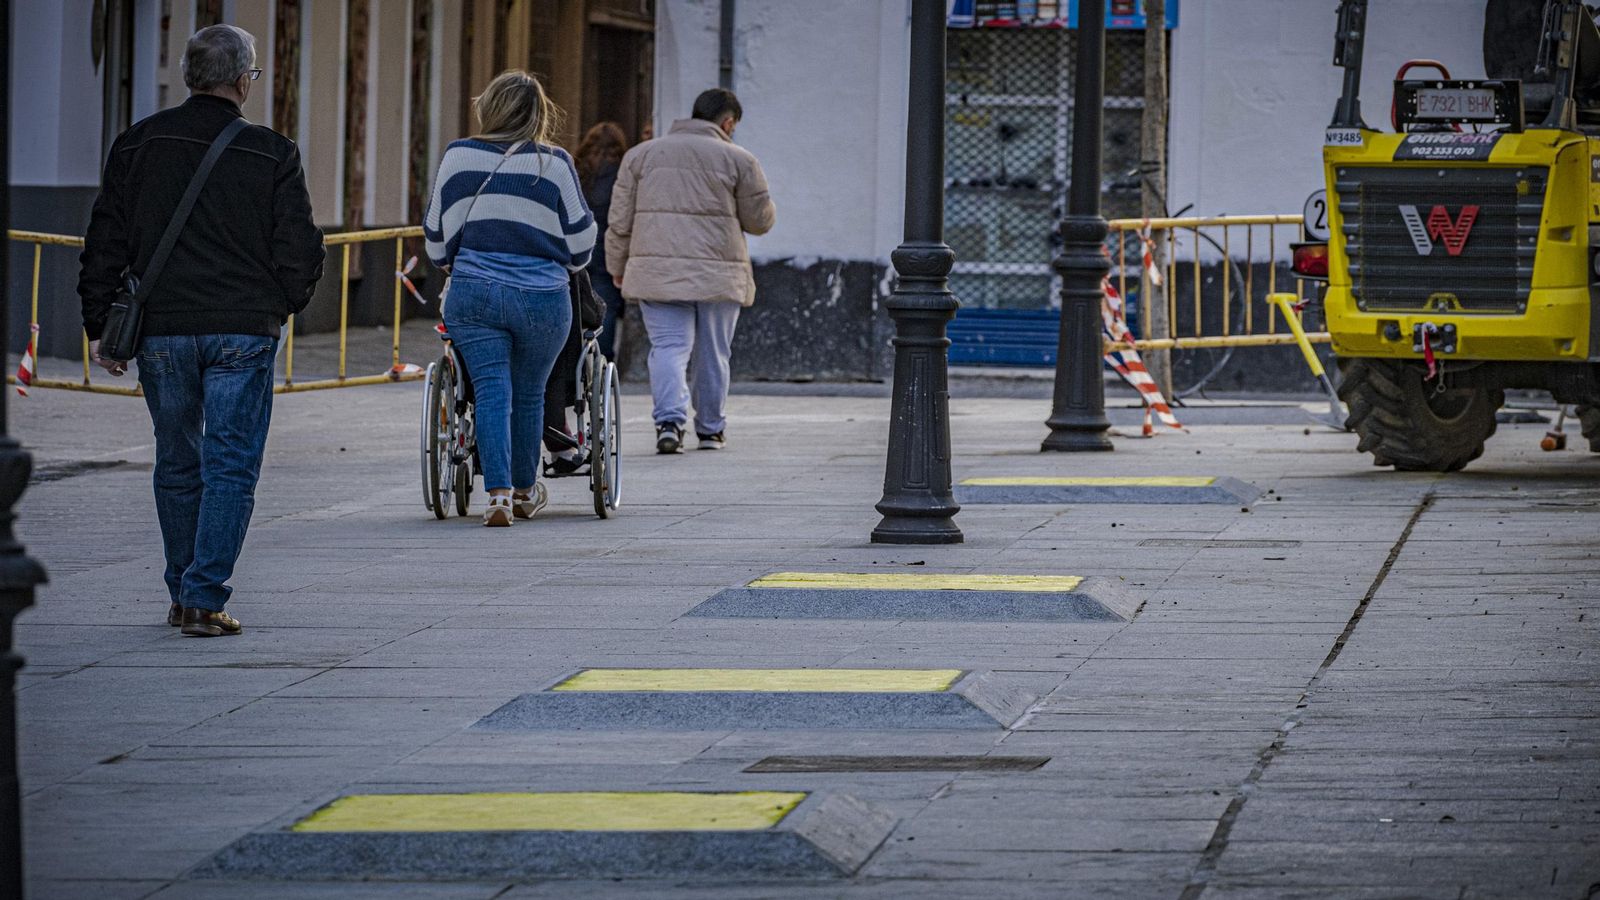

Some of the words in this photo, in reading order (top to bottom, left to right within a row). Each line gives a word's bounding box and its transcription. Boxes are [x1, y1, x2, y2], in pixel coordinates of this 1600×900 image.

[1418, 95, 1428, 112] E
[1467, 95, 1493, 112] BHK
[1411, 147, 1432, 155] 902
[1453, 147, 1475, 155] 070
[1314, 198, 1330, 230] 2
